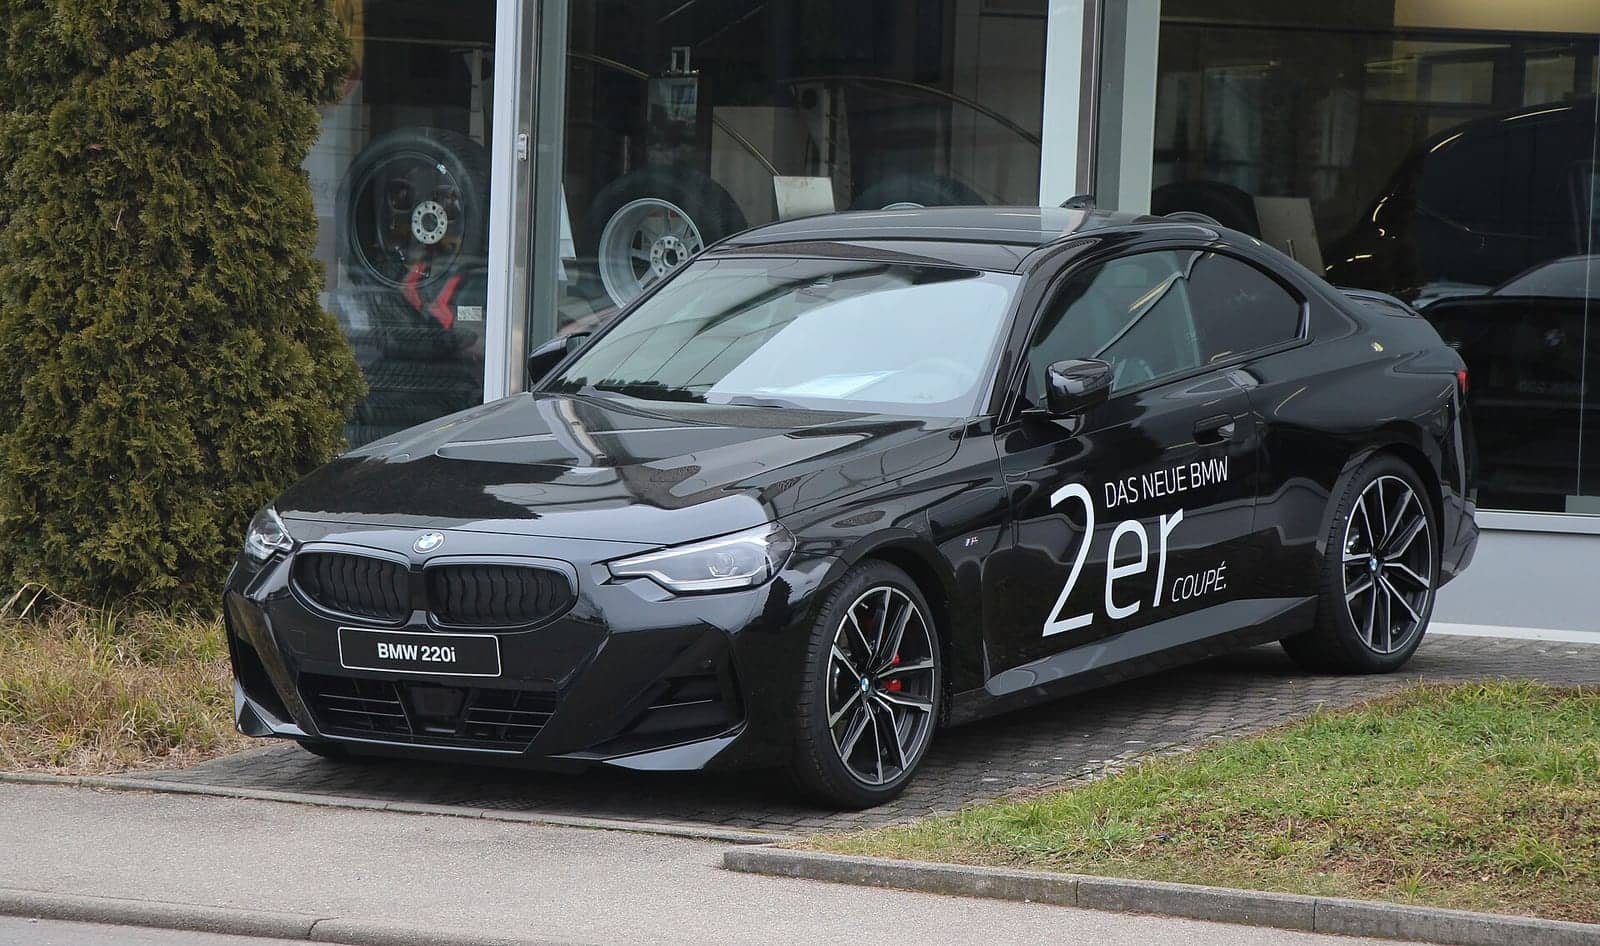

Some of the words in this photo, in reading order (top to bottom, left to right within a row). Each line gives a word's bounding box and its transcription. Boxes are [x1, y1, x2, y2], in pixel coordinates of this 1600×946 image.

[1104, 477, 1139, 508] DAS
[1142, 466, 1188, 500] NEUE
[1190, 456, 1228, 489] BMW
[1042, 483, 1184, 637] 2er
[377, 643, 418, 660] BMW
[420, 646, 456, 663] 220i
